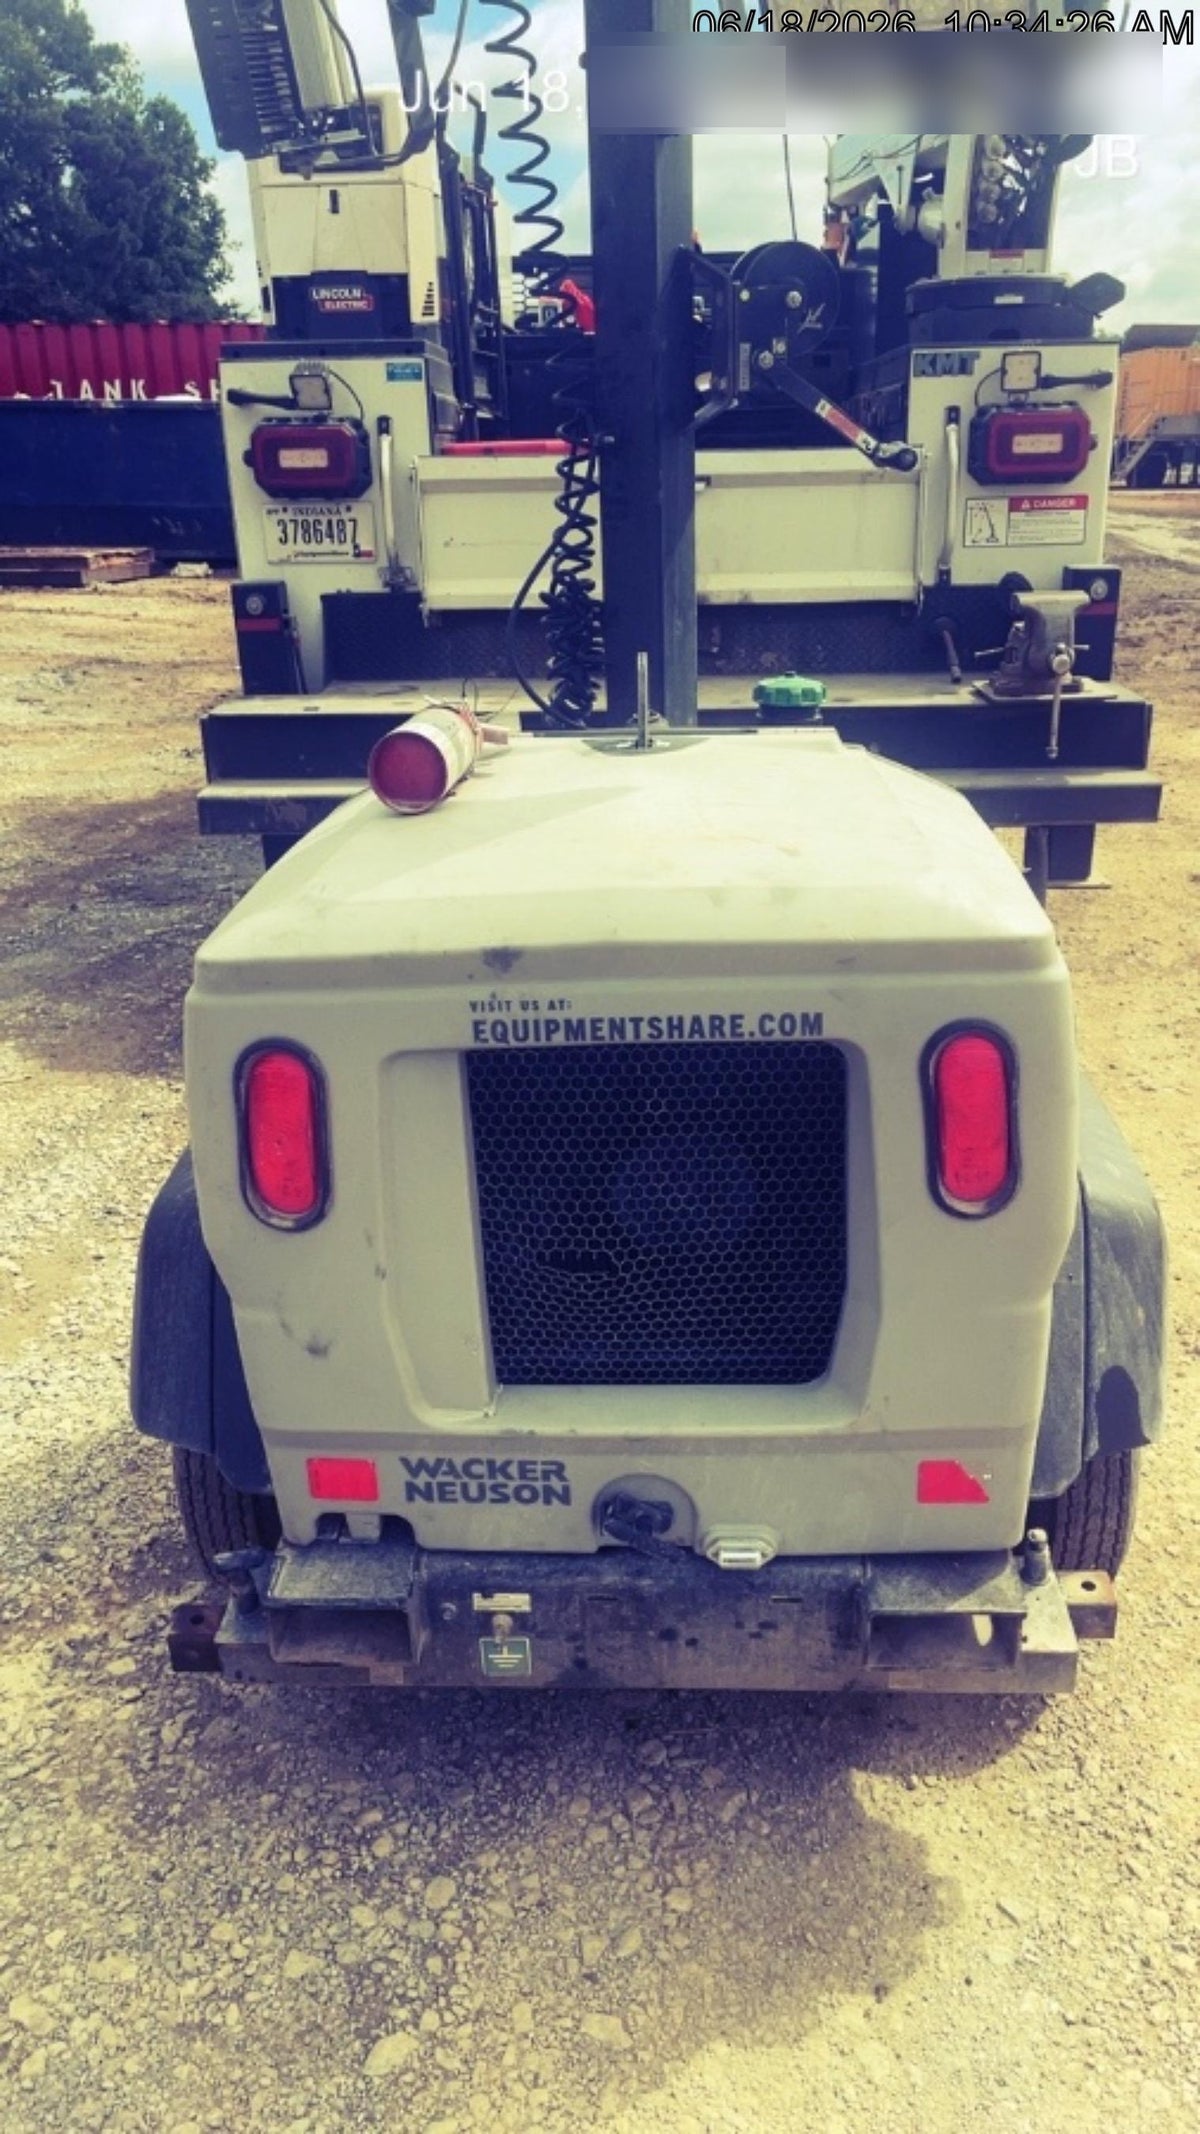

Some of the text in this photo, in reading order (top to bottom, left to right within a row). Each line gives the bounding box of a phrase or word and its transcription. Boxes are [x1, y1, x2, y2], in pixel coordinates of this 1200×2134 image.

[312, 288, 363, 300] LINCOLN
[323, 301, 370, 310] ELECTRIC
[913, 351, 980, 377] KMT
[469, 999, 573, 1013] VISIT US AT:
[472, 1012, 825, 1045] EQUIPMENTSHARE.COM
[399, 1457, 570, 1482] WACKER
[404, 1481, 572, 1507] NEUSON
